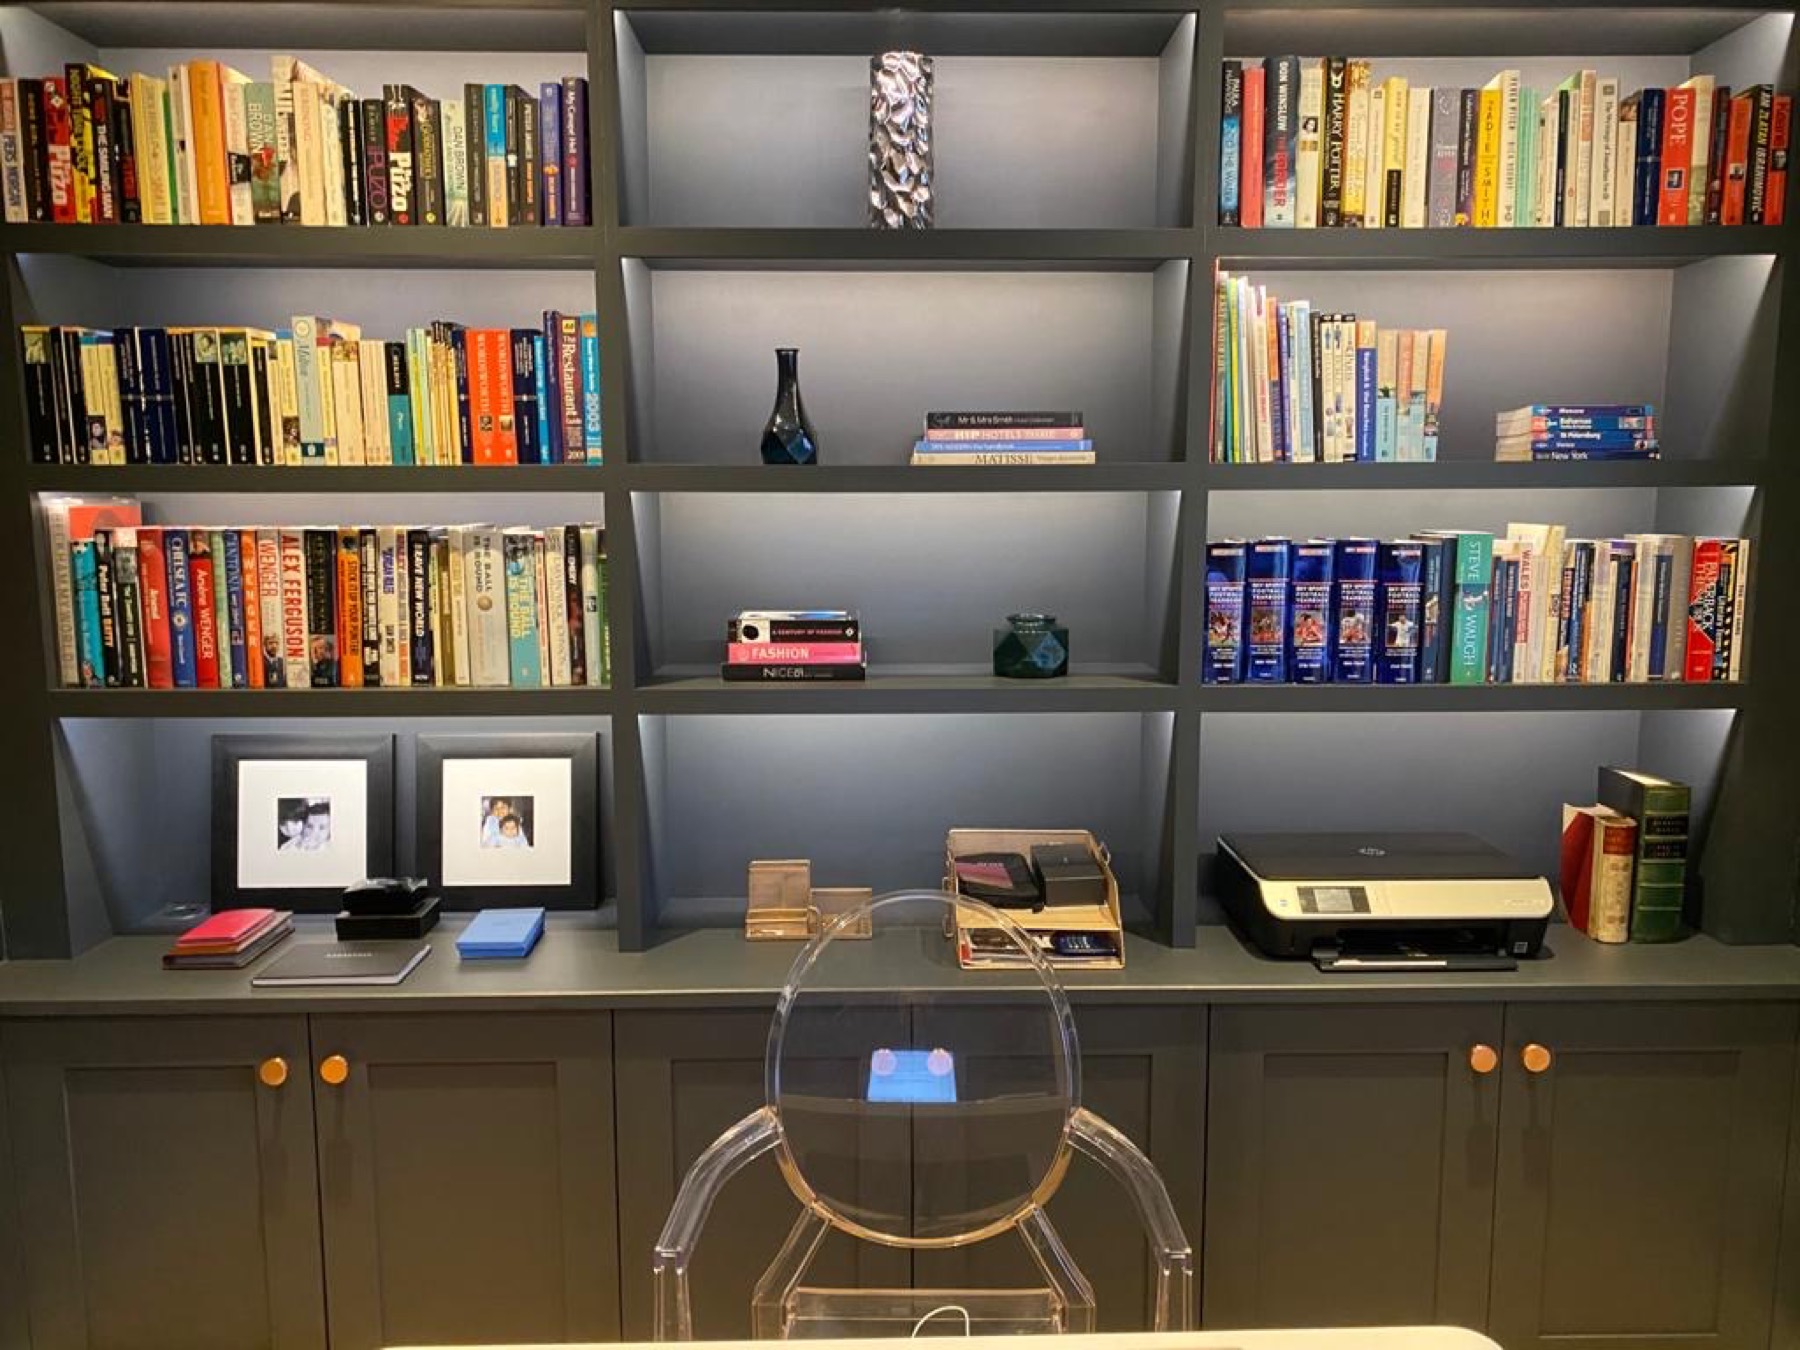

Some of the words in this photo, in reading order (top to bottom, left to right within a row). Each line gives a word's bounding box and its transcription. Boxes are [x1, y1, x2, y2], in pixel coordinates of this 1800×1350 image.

[1279, 61, 1289, 81] DON
[1277, 84, 1288, 131] WINSLOW
[1331, 92, 1345, 138] HARRY
[1670, 93, 1689, 145] POPE
[1756, 109, 1769, 144] ZLATAN
[4, 134, 17, 162] PIERS
[97, 125, 107, 146] THE
[247, 103, 263, 154] BROWN
[263, 113, 273, 143] DAN
[453, 126, 464, 149] DAN
[49, 145, 70, 206] Puzo
[98, 147, 111, 191] SMILING
[389, 152, 412, 212] Puzo
[454, 150, 466, 190] BROWN
[1329, 142, 1344, 190] POTTER
[6, 166, 21, 207] MORGAN
[103, 192, 114, 219] MAN
[477, 333, 490, 413] WORDSWORTH
[498, 333, 512, 414] WORDSWORTH
[562, 344, 578, 417] Restaurant
[282, 535, 302, 578] ALEX
[474, 536, 482, 547] IS
[483, 537, 492, 558] THE
[1468, 541, 1481, 581] STEVE
[98, 565, 109, 593] Peter
[171, 537, 188, 591] CHELSEA
[225, 532, 241, 592] CANTONA
[260, 541, 279, 597] WENGER
[347, 560, 358, 581] STICK
[473, 551, 484, 593] ROUND
[484, 564, 493, 592] BALL
[1520, 550, 1532, 589] WALES
[149, 589, 161, 620] Arsenal
[176, 591, 188, 608] FC
[415, 576, 425, 601] NEW
[519, 577, 531, 601] THE
[1703, 562, 1719, 631] PAPERBACK
[285, 580, 305, 658] FERGUSON
[350, 603, 359, 623] YOUR
[415, 602, 426, 638] WORLD
[509, 594, 521, 639] ROUND
[520, 606, 533, 638] BALL
[198, 607, 214, 660] WENGER
[1463, 614, 1478, 665] WAUGH
[751, 648, 807, 660] FASHION
